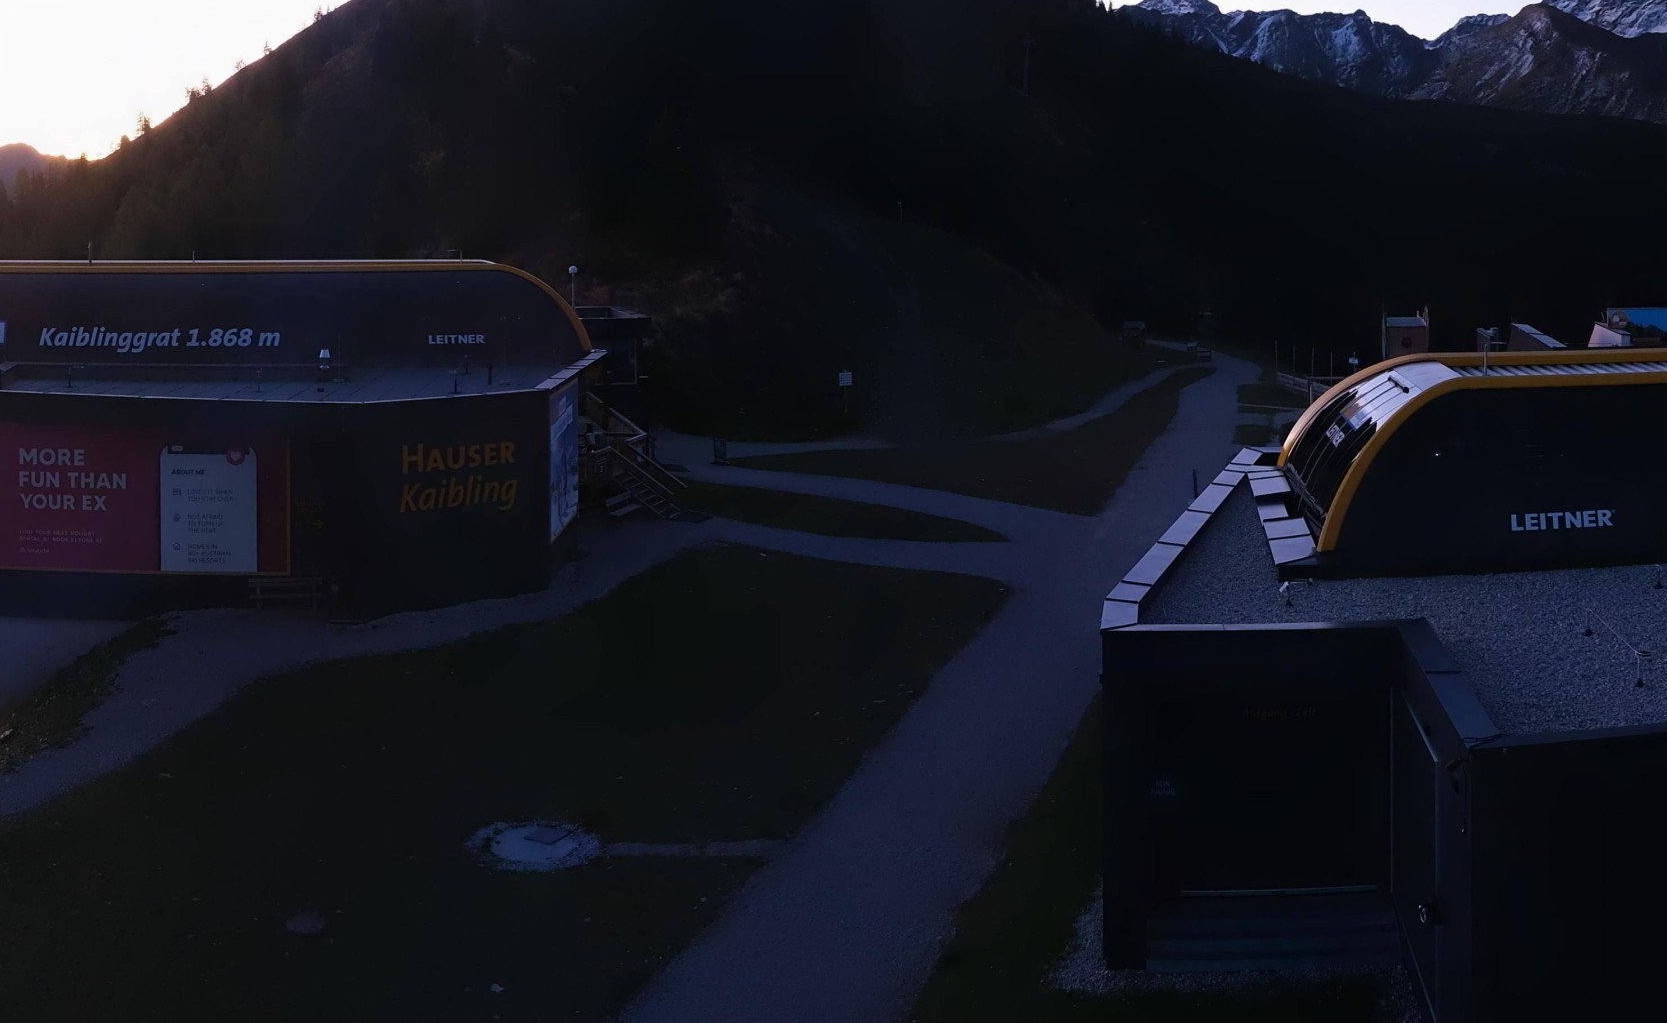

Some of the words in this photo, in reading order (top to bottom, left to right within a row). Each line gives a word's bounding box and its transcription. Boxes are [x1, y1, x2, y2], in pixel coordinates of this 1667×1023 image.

[39, 326, 179, 354] Kaiblinggrat
[186, 327, 253, 347] 1.868
[258, 332, 281, 347] m
[428, 334, 485, 345] LEITNER
[19, 448, 86, 466] MORE
[401, 441, 516, 474] HAUSER
[19, 471, 60, 488] FUN
[67, 472, 127, 489] THAN
[20, 494, 75, 510] YOUR
[82, 495, 107, 511] EX
[399, 475, 517, 513] Kaibling
[1510, 509, 1614, 532] LEITNER
